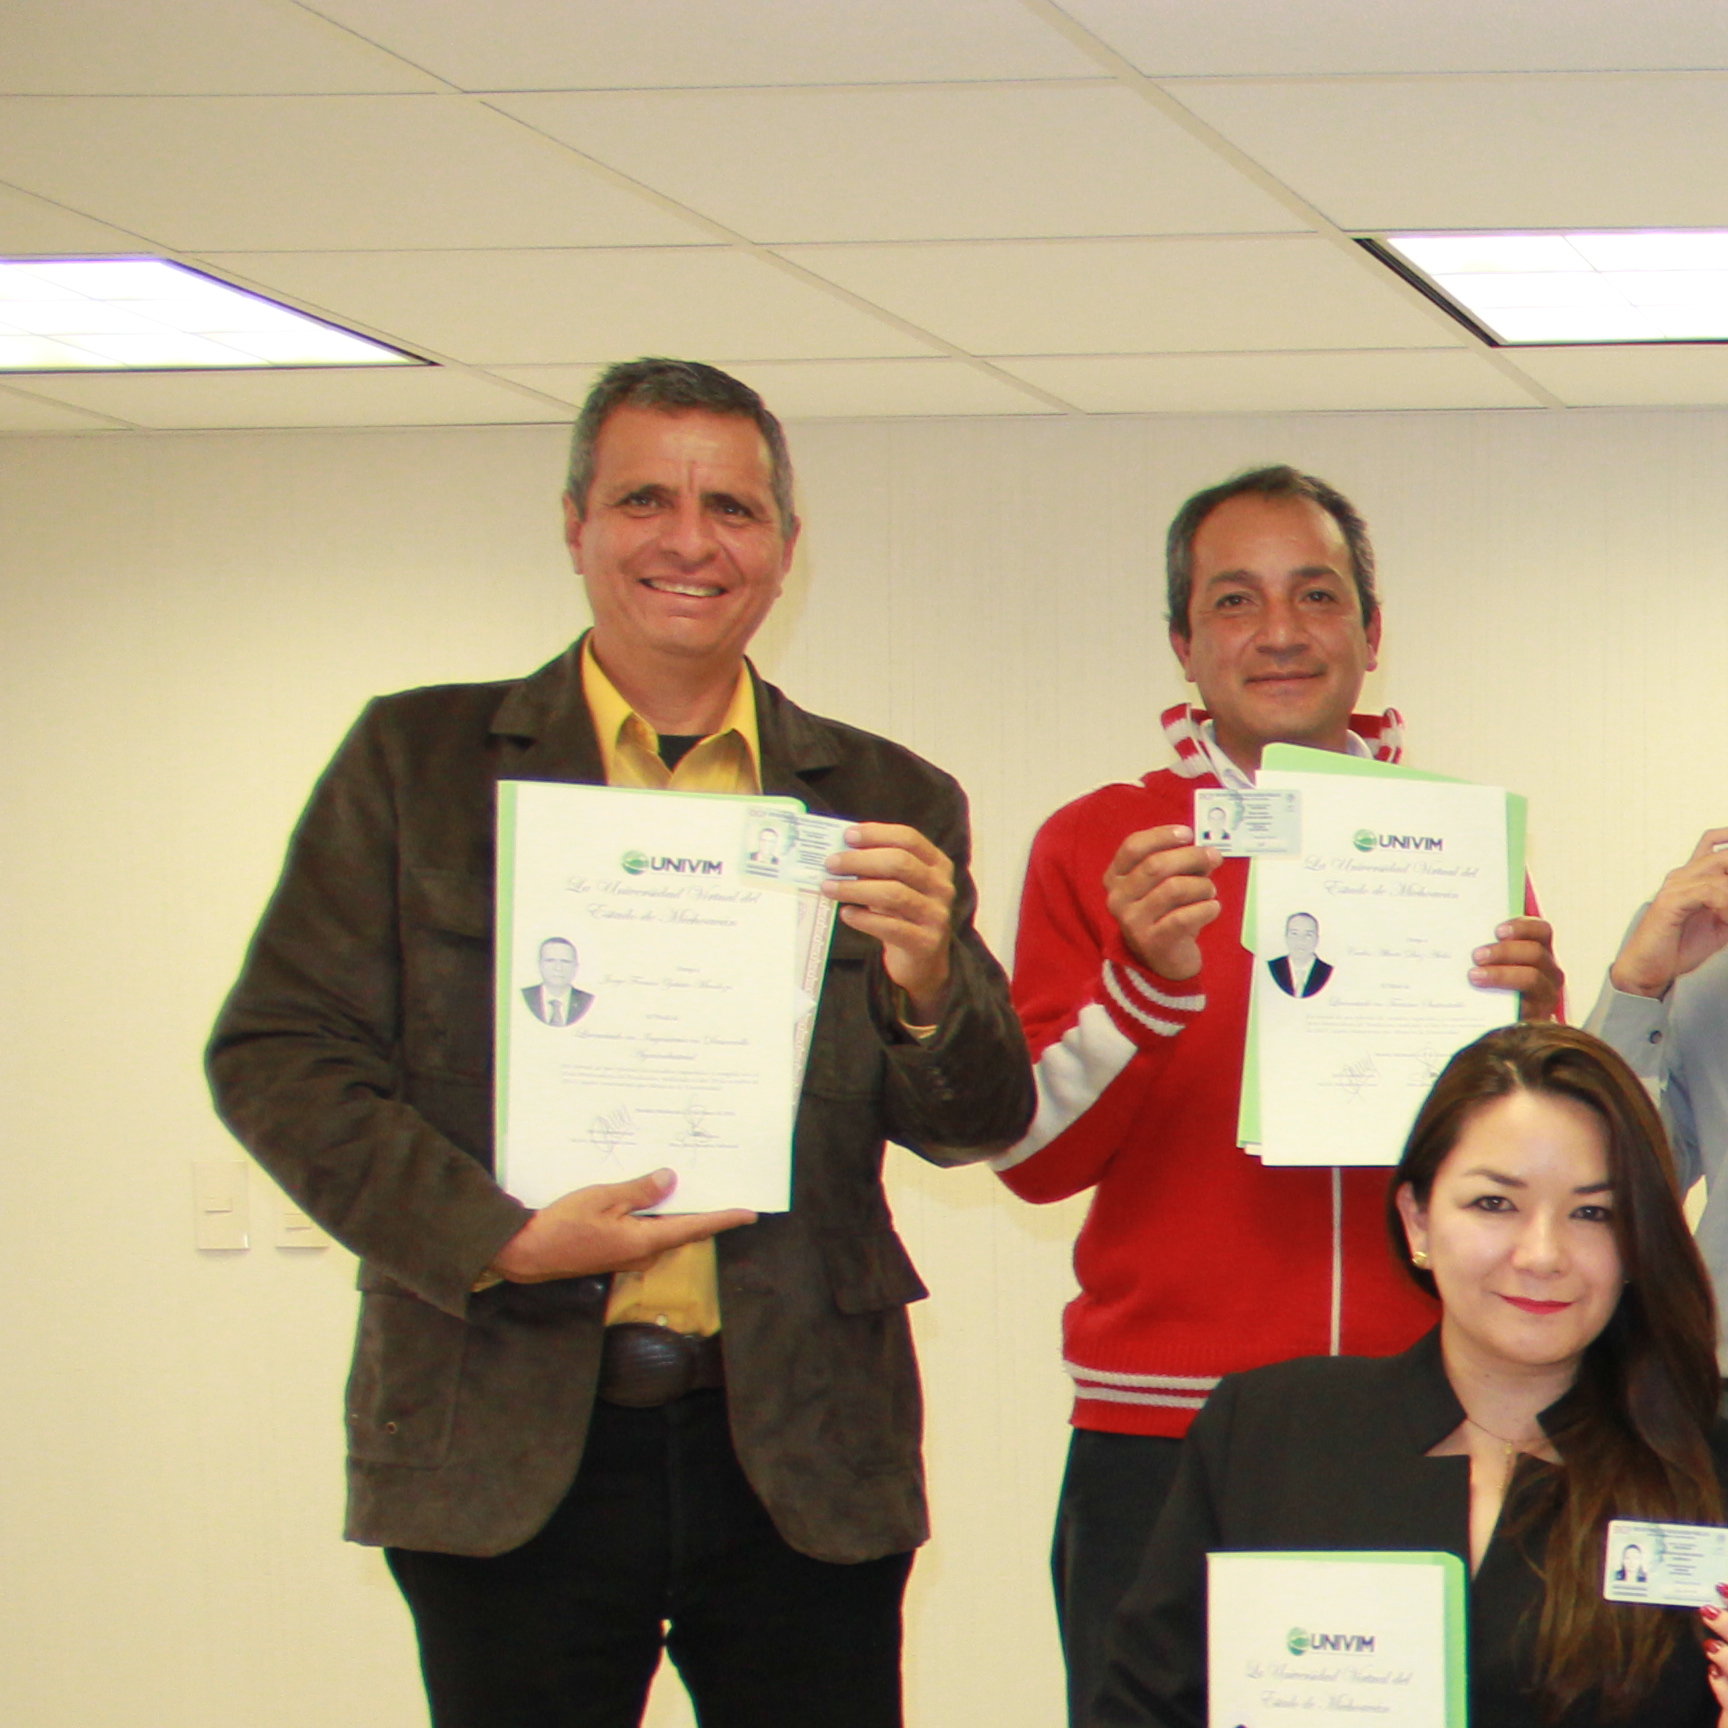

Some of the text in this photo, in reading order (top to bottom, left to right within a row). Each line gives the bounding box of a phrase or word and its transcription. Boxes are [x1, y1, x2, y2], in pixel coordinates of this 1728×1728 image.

[1379, 834, 1443, 851] UNIVIM
[650, 856, 723, 875] UNIVIM
[1311, 1633, 1375, 1652] UNIVIM
